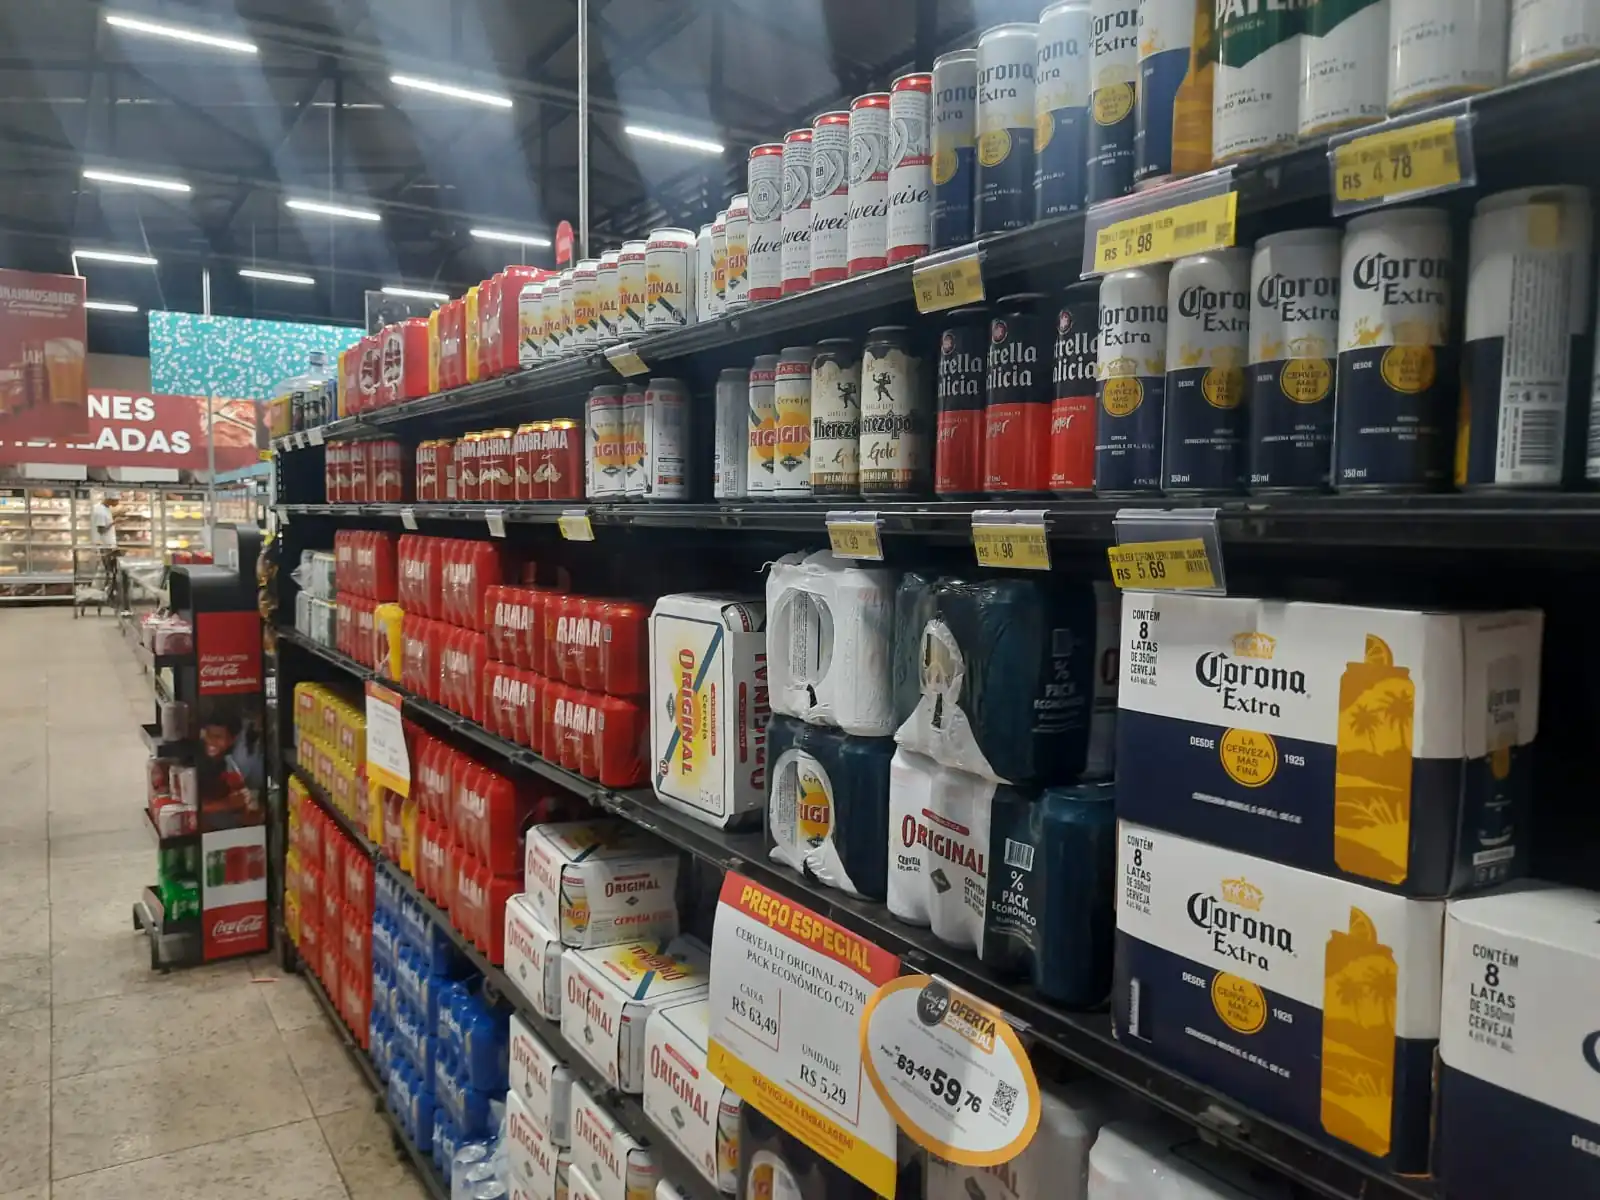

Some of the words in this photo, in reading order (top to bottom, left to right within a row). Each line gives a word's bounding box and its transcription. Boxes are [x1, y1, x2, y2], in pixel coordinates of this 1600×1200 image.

[1132, 608, 1160, 621] CONTÉM
[1139, 621, 1149, 639] 8
[1131, 639, 1158, 653] LATAS
[1131, 663, 1157, 677] CERVEJA
[1195, 651, 1307, 694] Corona
[1223, 688, 1281, 717] Extra
[1190, 735, 1215, 750] DESDE
[1226, 743, 1272, 760] CERVEZA
[1284, 753, 1306, 767] 1925
[902, 815, 986, 878] ORIGINAL
[1133, 849, 1143, 867] 8
[1126, 863, 1152, 882] LATAS
[605, 879, 661, 898] ORIGINAL
[1002, 890, 1029, 911] PACK
[740, 884, 790, 929] PREÇO
[790, 911, 872, 974] ESPECIAL
[1187, 892, 1296, 954] Corona
[735, 926, 773, 957] CERVEJA
[787, 954, 837, 988] ORIGINAL
[838, 979, 854, 997] 473
[746, 950, 770, 971] PACK
[1213, 930, 1270, 971] Extra
[1472, 943, 1520, 969] CONTÉM
[1182, 971, 1207, 988] DESDE
[1485, 963, 1500, 987] 8
[740, 984, 764, 1004] CAIXA
[1470, 983, 1516, 1009] LATAS
[732, 996, 746, 1018] R$
[749, 1004, 777, 1037] 63,49
[950, 999, 996, 1038] OFERTA
[1272, 1007, 1294, 1024] 1925
[1469, 1013, 1514, 1041] CERVEJA
[650, 1043, 711, 1127] ORIGINAL
[800, 1064, 817, 1089] R$
[820, 1077, 847, 1106] 5,29
[575, 1107, 622, 1181] ORIGINAL
